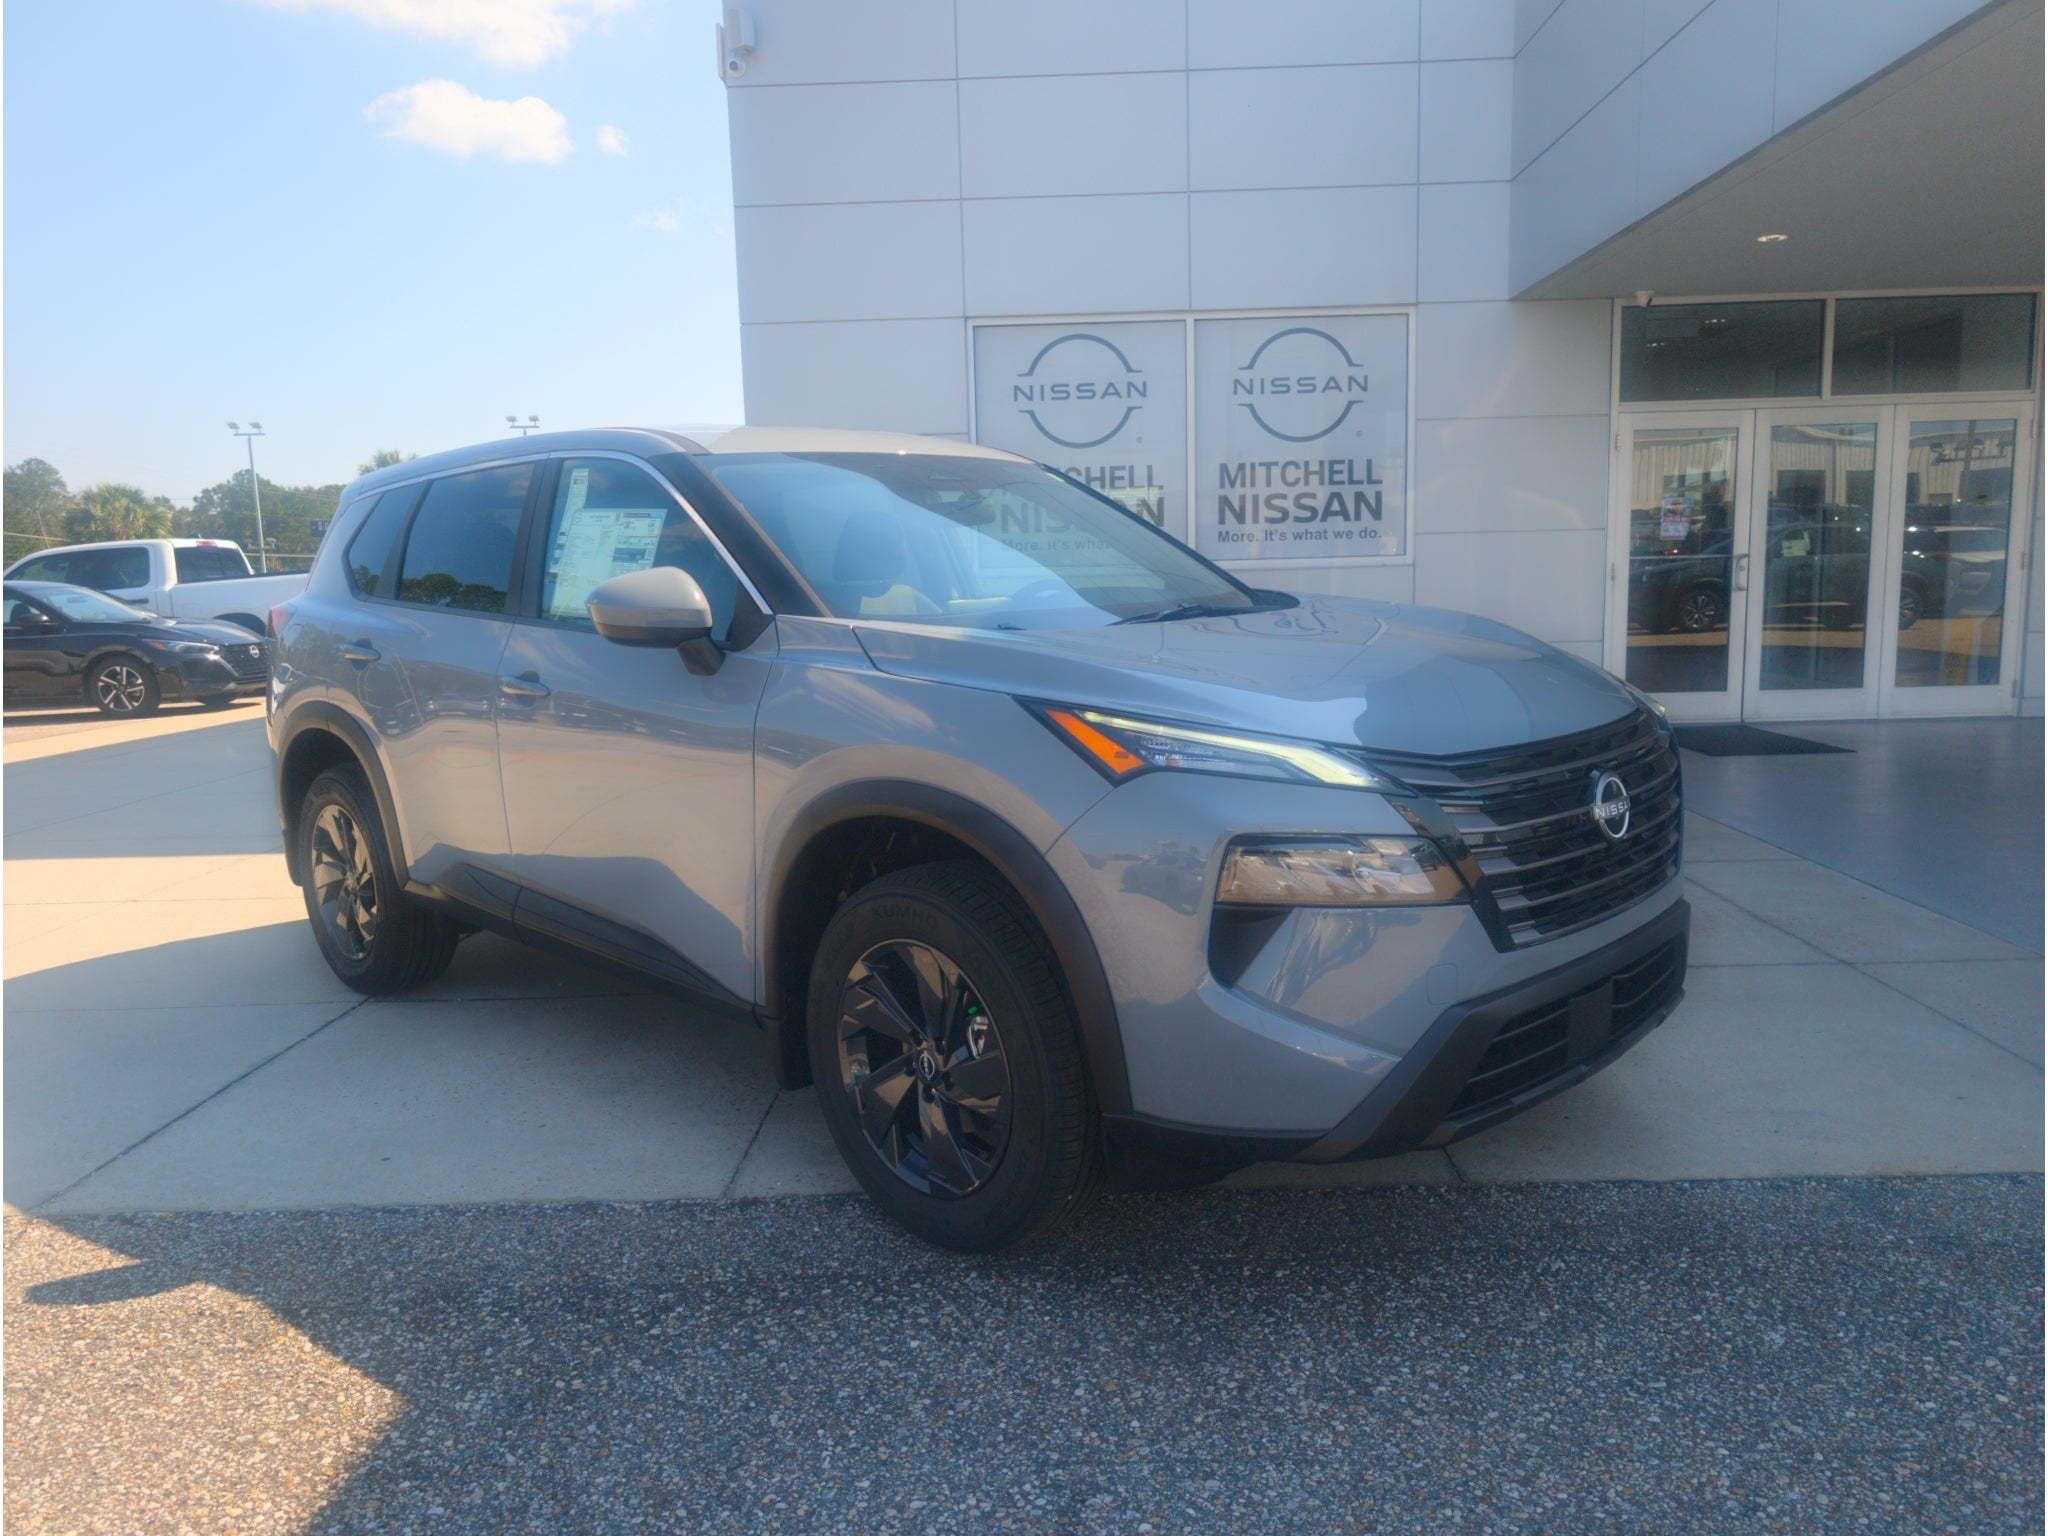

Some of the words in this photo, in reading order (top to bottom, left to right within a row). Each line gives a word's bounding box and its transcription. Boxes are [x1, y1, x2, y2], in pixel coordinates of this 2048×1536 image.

[1013, 380, 1148, 402] NISSAN
[1233, 374, 1369, 396] NISSAN
[1056, 464, 1164, 492] CHELL
[1219, 459, 1383, 489] MITCHELL
[1217, 491, 1383, 525] NISSAN
[1218, 530, 1259, 543] More.
[1265, 529, 1288, 541] It's
[1292, 528, 1328, 541] what
[1333, 530, 1353, 540] we
[1358, 527, 1382, 540] do.
[871, 903, 939, 930] KUMHO
